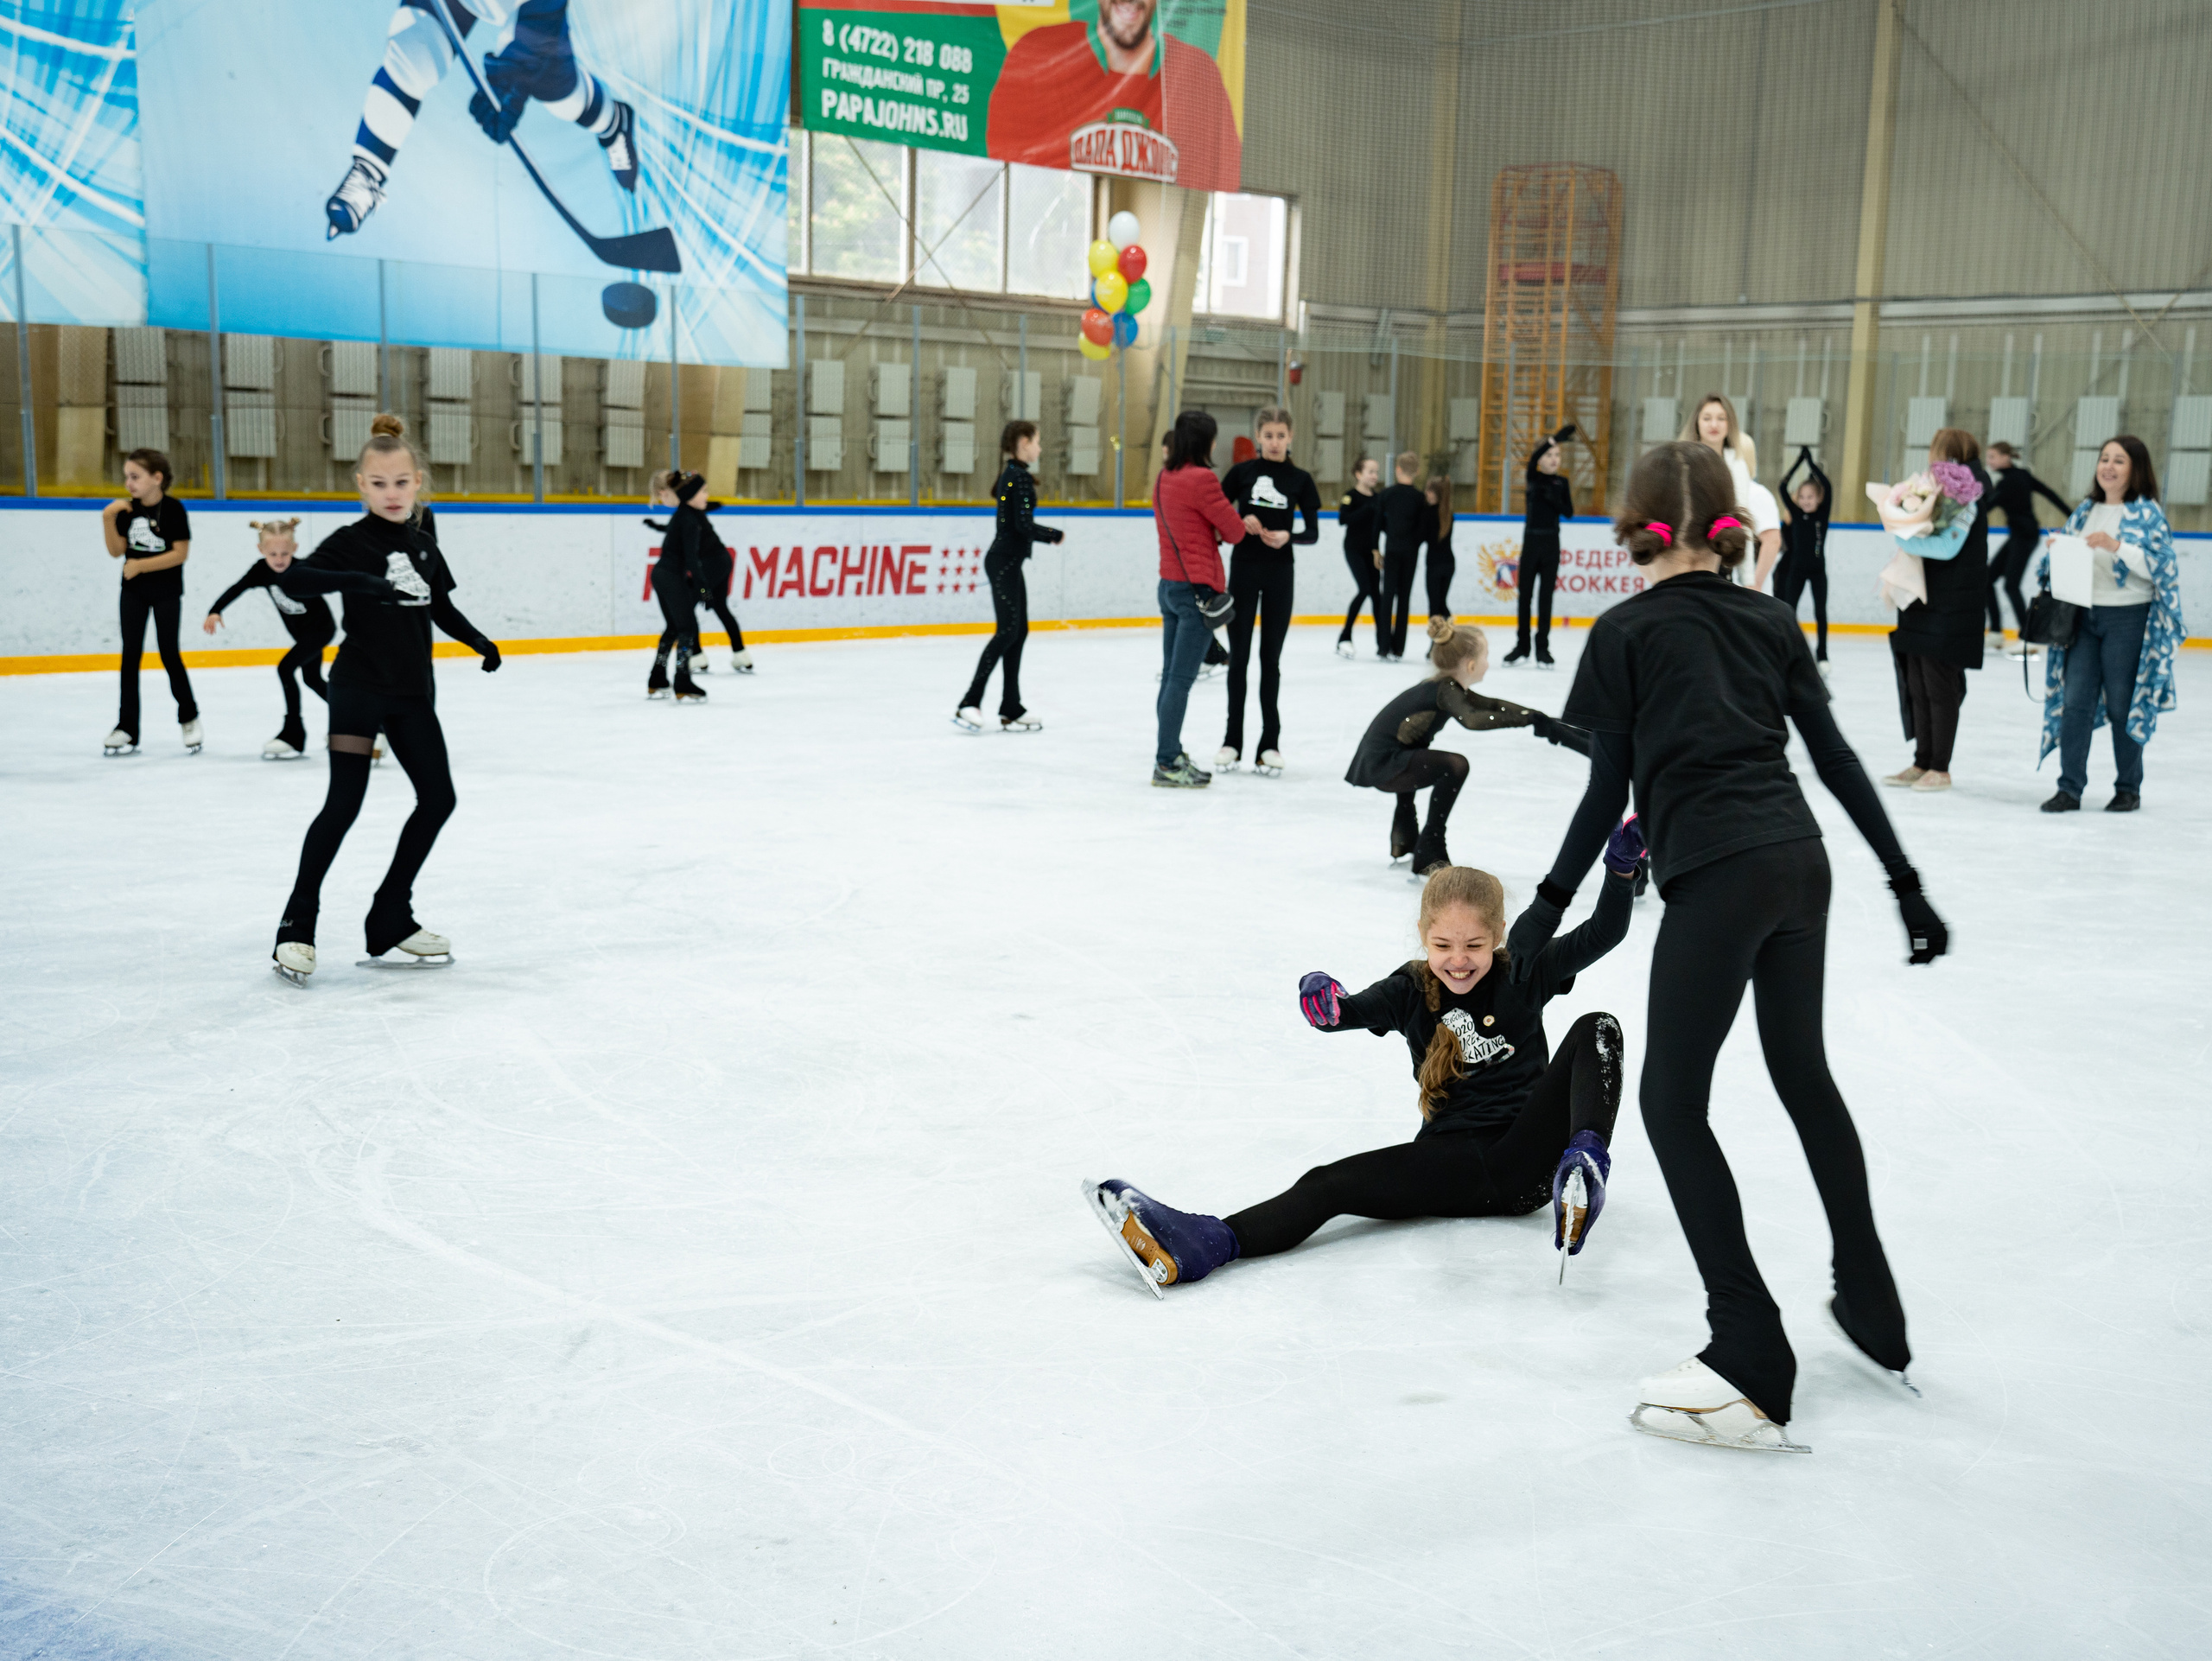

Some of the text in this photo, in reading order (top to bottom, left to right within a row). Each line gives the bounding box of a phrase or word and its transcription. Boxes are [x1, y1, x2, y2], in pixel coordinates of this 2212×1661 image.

[823, 18, 973, 73] 8 (4722) 218 088
[823, 57, 925, 96] ГРАЖДАНСКИЙ
[822, 88, 968, 142] PAPAJOHNS.RU
[744, 545, 932, 600] MACHINE
[1554, 575, 1645, 593] ХОККЕЯ
[1455, 1021, 1473, 1037] 020
